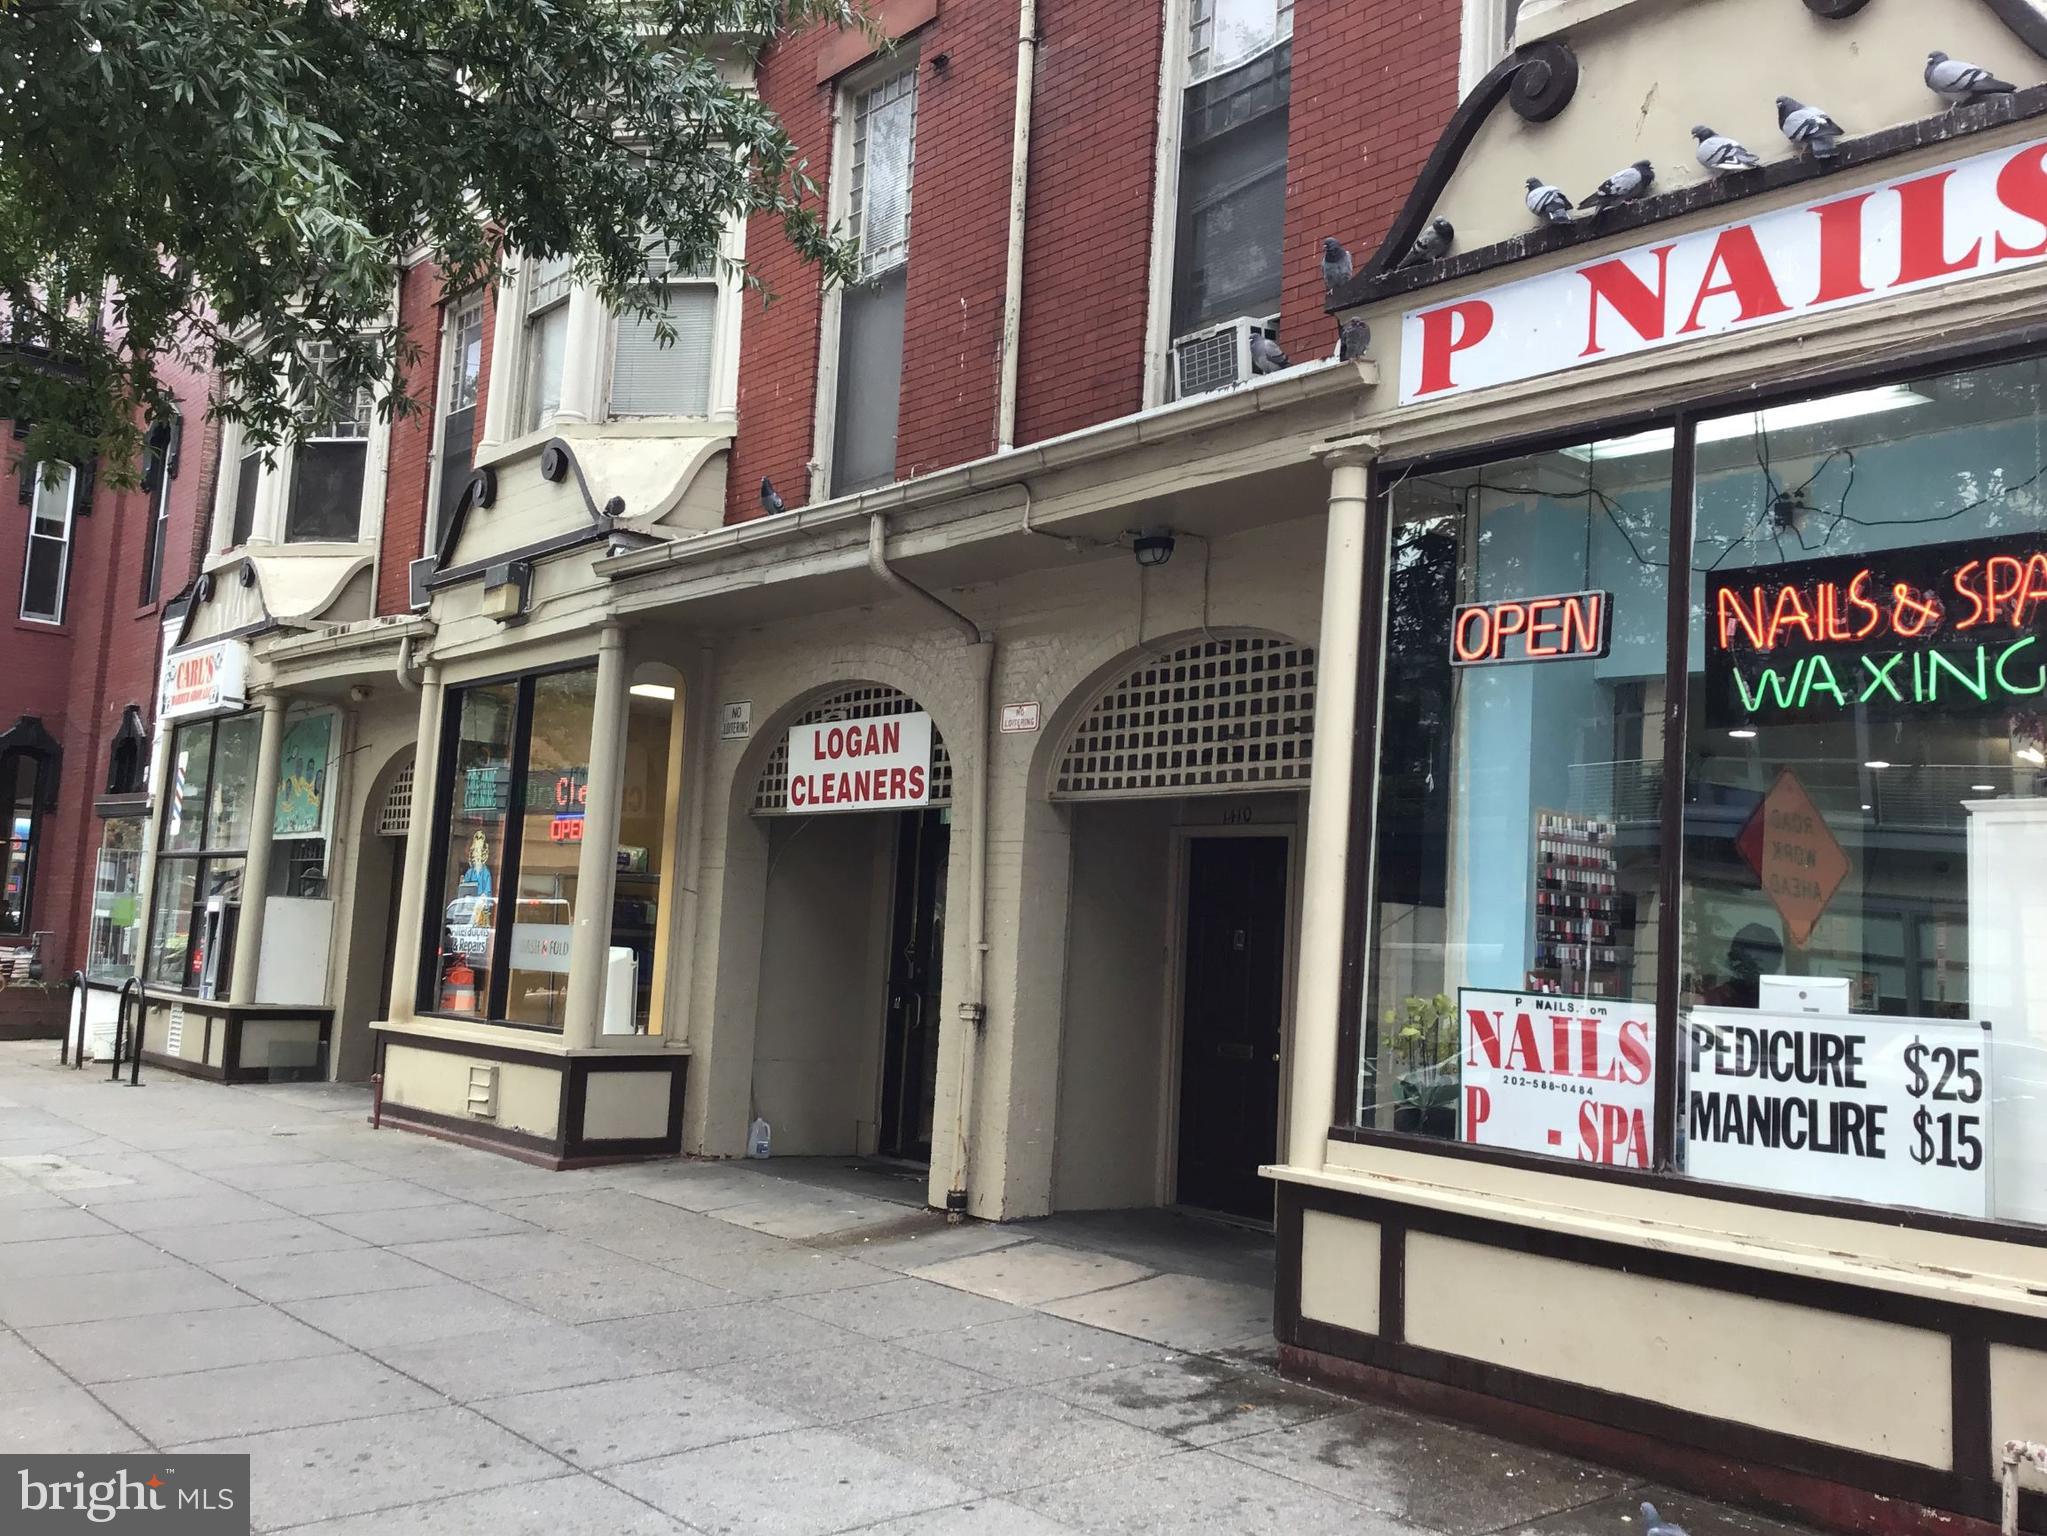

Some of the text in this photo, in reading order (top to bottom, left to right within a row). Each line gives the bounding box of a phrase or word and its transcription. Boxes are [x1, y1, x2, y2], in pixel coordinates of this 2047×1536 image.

[1413, 142, 2047, 396] P NAILS
[1455, 595, 1600, 661] OPEN
[1717, 553, 2047, 651] NAILS & SPA
[176, 655, 215, 690] CARL'S
[1732, 635, 2047, 712] WAXING
[731, 706, 742, 719] NO
[814, 721, 900, 761] LOGAN
[791, 765, 926, 806] CLEANERS
[460, 938, 487, 954] Repairs
[549, 940, 570, 956] FOLD
[1515, 997, 1523, 1007] P
[1466, 1009, 1652, 1085] NAILS
[1690, 1023, 1983, 1104] PEDICURE $25
[1503, 1075, 1594, 1096] 202-588-0484
[1464, 1085, 1491, 1144] P
[1578, 1099, 1650, 1170] SPA
[1909, 1104, 1983, 1171] $15
